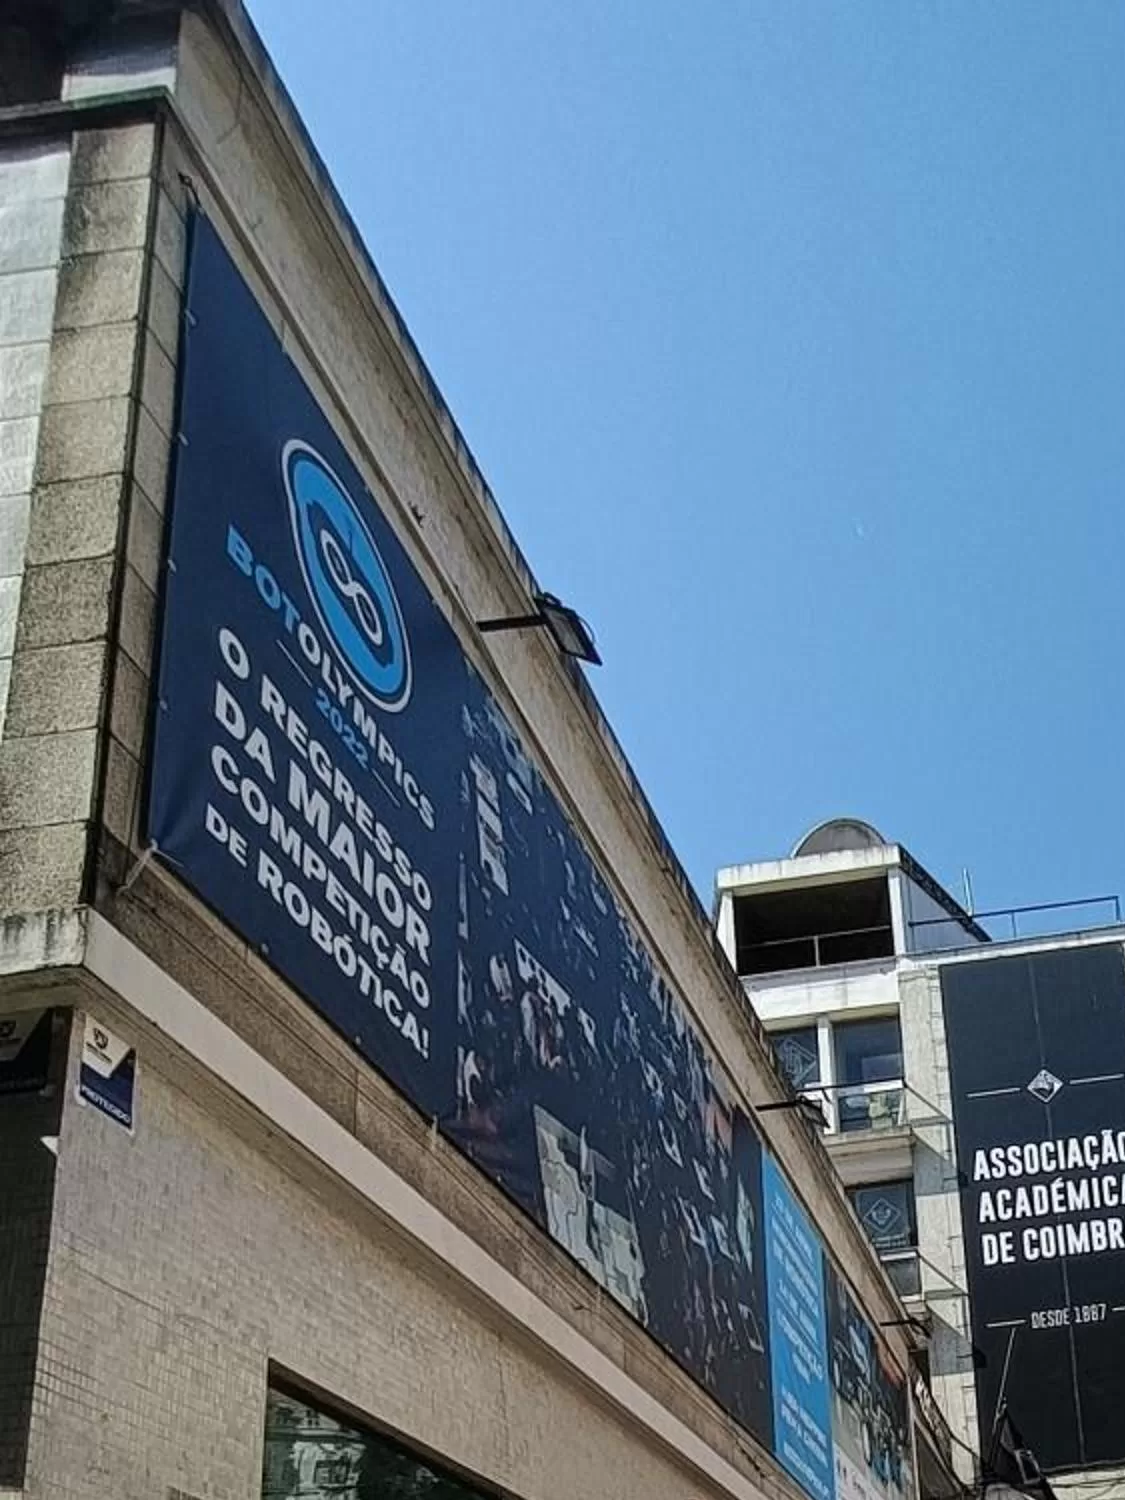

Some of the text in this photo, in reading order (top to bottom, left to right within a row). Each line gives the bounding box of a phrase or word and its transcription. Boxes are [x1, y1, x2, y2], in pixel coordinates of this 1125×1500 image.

[218, 626, 432, 914] O REGRESSO
[225, 524, 435, 830] BOTOLYMPICS
[315, 690, 373, 773] 2022
[204, 802, 431, 1060] DE ROBÓTICA!
[210, 743, 431, 1011] COMPETIÇÃO
[214, 682, 431, 967] DA MAIOR
[981, 1230, 1016, 1266] DE
[1031, 1308, 1071, 1330] DESDE
